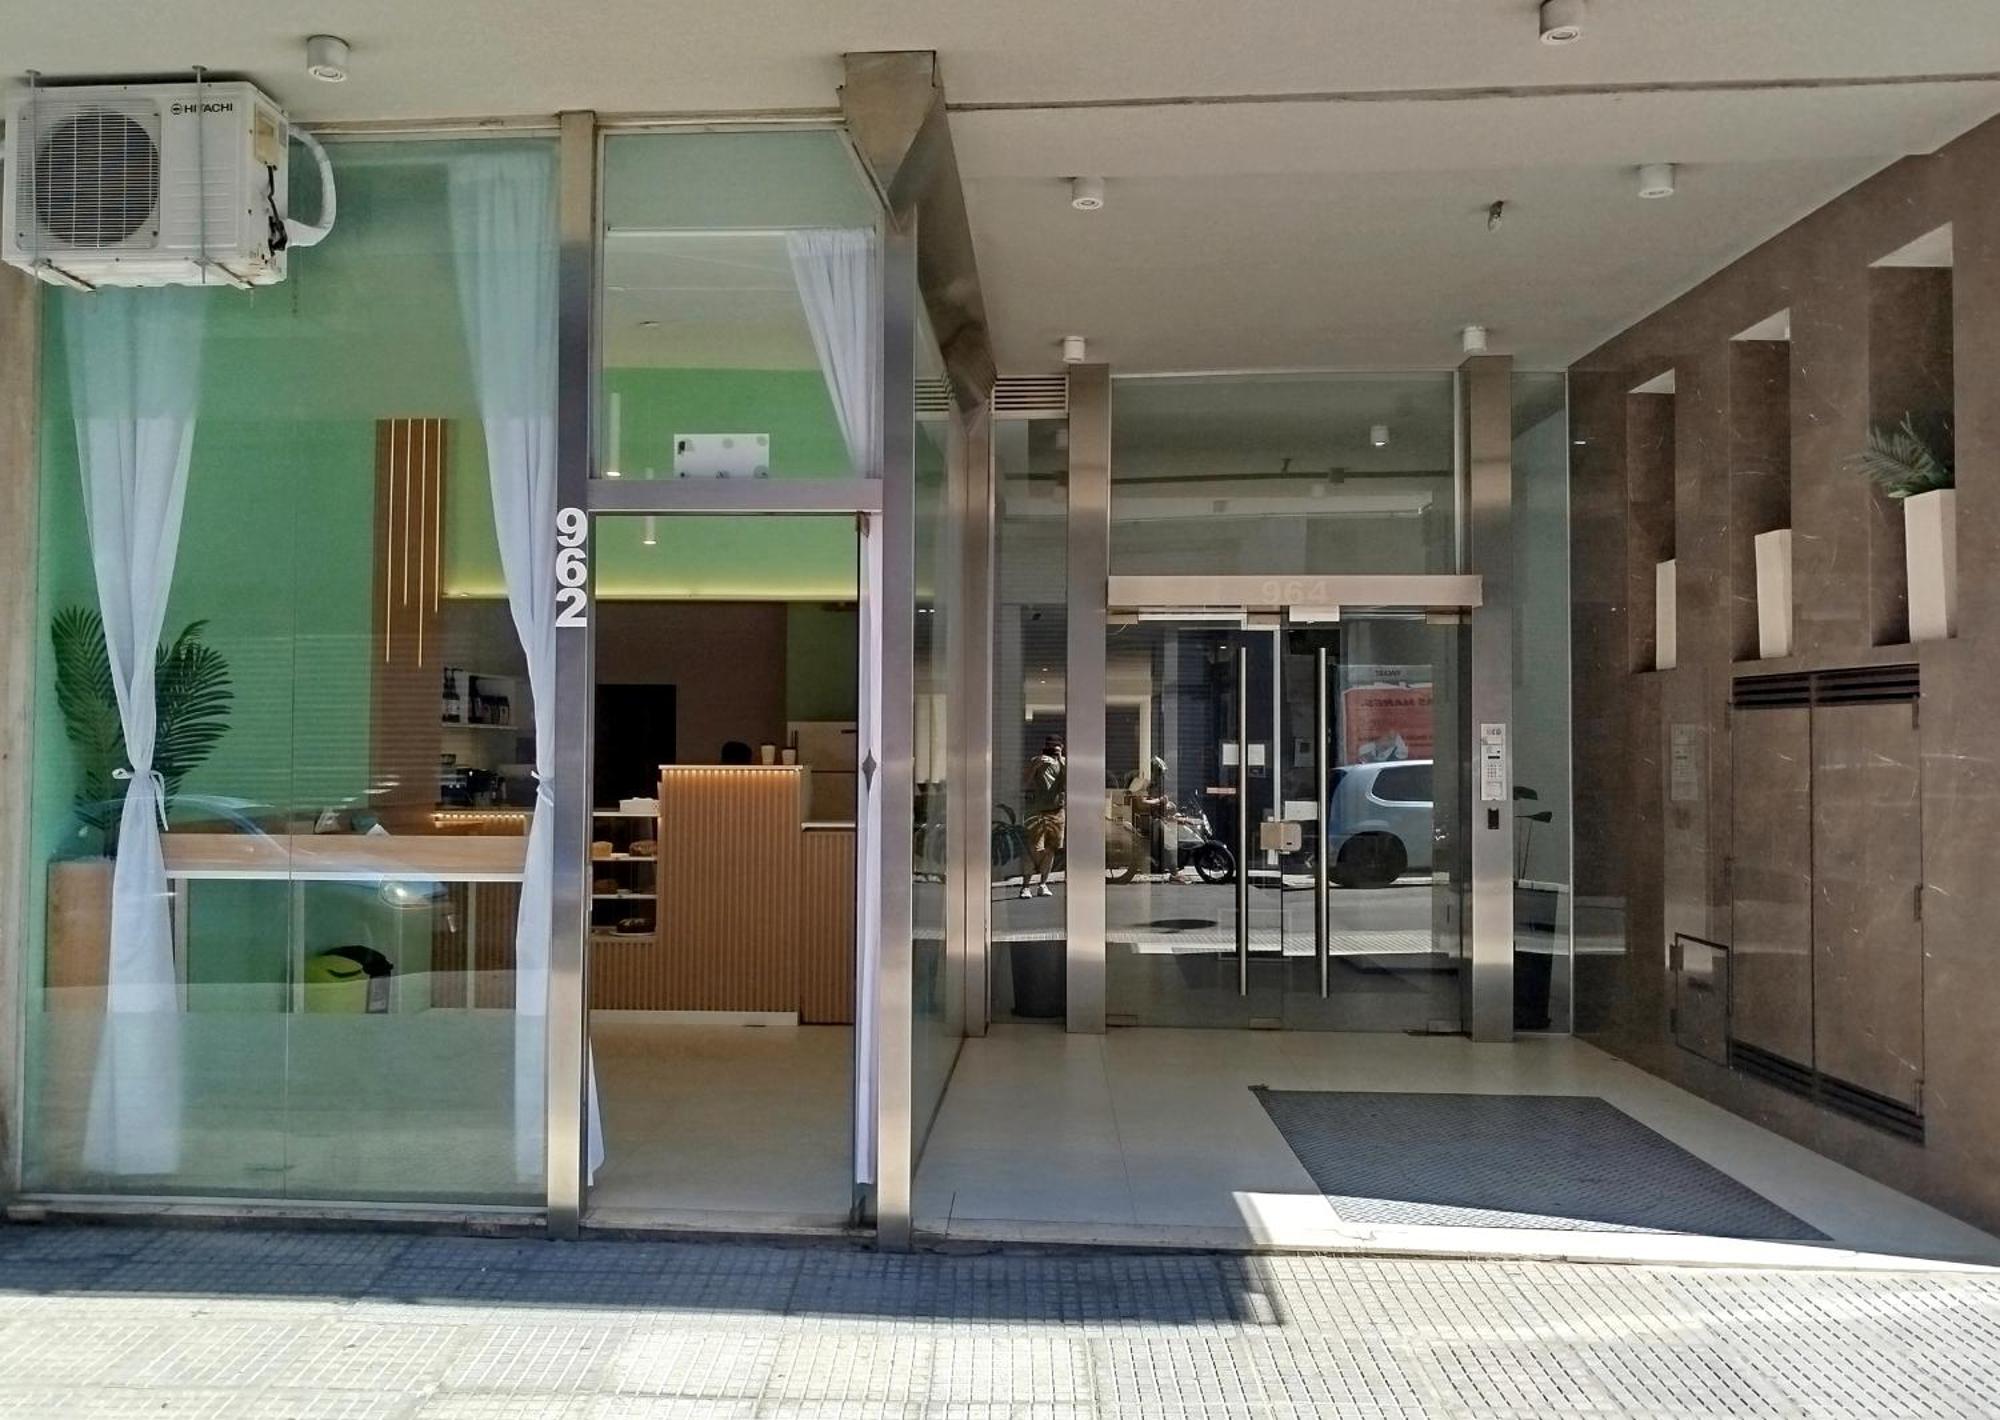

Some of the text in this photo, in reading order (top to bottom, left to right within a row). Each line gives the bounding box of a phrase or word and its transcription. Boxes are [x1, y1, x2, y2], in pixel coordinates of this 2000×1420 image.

[184, 103, 233, 113] HIACHI
[556, 507, 588, 627] 962
[1262, 580, 1329, 602] 964
